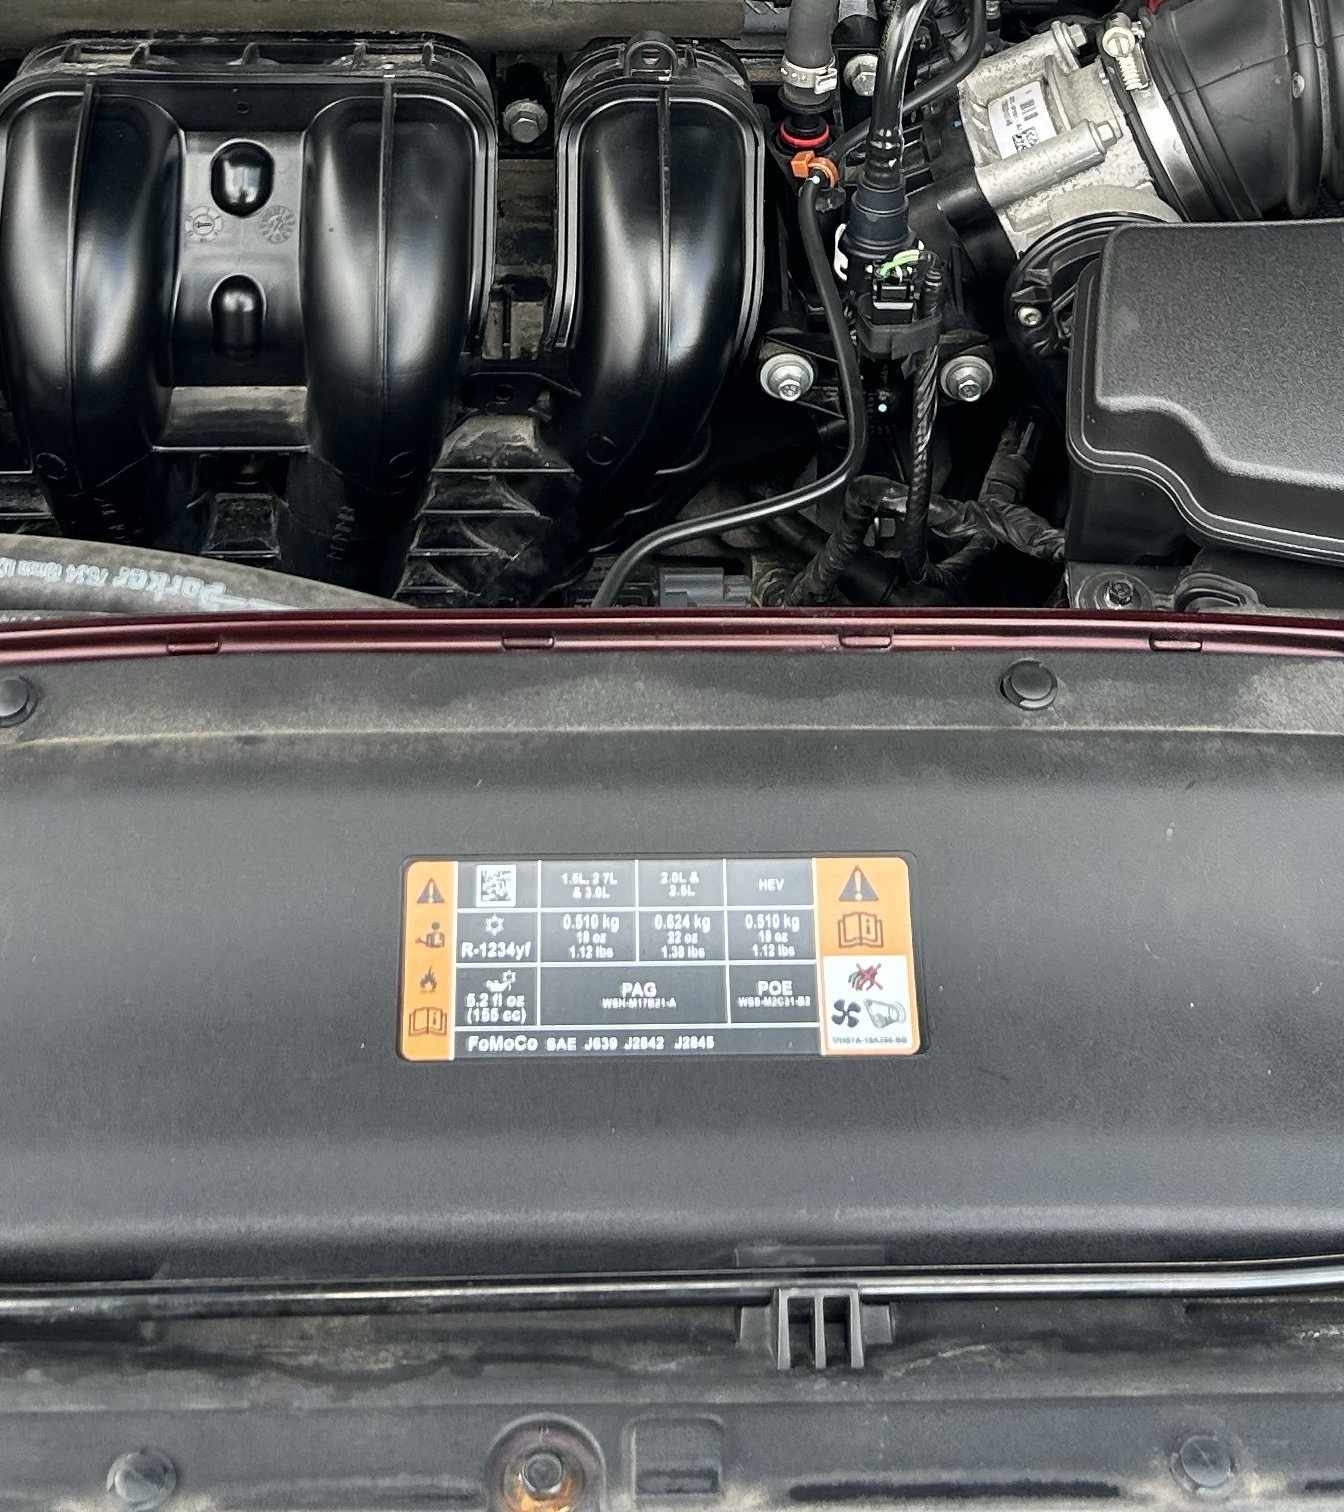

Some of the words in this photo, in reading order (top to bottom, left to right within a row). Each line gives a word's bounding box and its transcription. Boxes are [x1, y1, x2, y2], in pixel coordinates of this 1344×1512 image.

[758, 877, 784, 891] HEV
[602, 913, 620, 933] kg
[694, 913, 711, 933] kg
[745, 913, 780, 929] 0.510
[783, 913, 800, 932] kg
[592, 933, 606, 944] oz
[684, 933, 698, 944] oz
[774, 932, 788, 943] oz
[461, 941, 532, 961] R-1234yf
[596, 945, 614, 959] lbs
[687, 945, 706, 959] lbs
[777, 944, 795, 957] lbs
[621, 982, 657, 997] PAG
[757, 980, 793, 996] POE
[506, 995, 525, 1008] oz
[468, 1034, 539, 1052] FoMoCo
[546, 1037, 577, 1051] SAE
